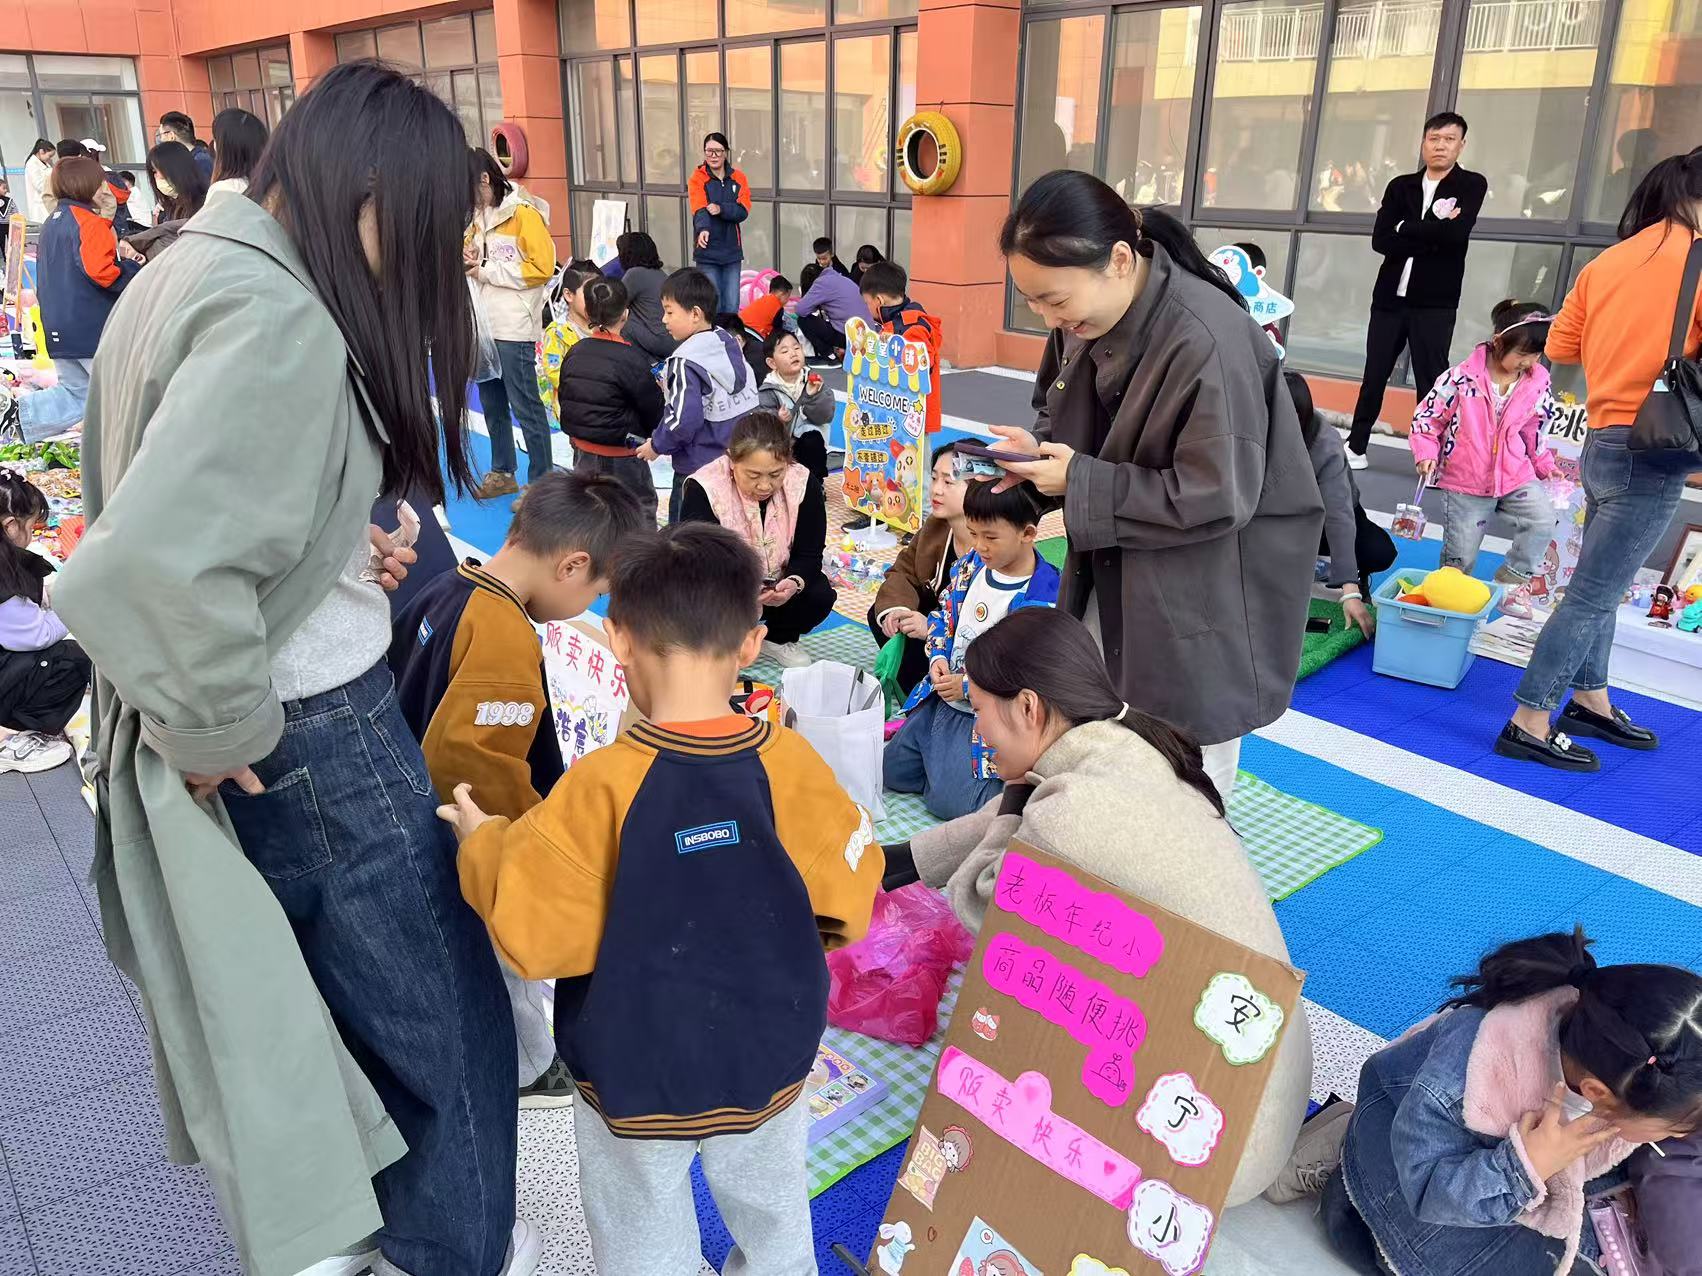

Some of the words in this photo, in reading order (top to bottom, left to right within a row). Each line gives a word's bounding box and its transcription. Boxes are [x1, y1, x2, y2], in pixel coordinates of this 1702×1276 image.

[1253, 301, 1277, 314] 商店
[859, 385, 910, 413] WELCOME
[860, 424, 890, 438] 走过路过
[857, 451, 885, 464] 不要错过
[545, 622, 627, 699] 贩卖快乐
[474, 702, 535, 726] 1998
[684, 828, 730, 847] INSBOBO
[1001, 865, 1142, 957] 老板年纪小
[994, 943, 1140, 1048] 商品随便挑
[959, 1066, 1085, 1170] 贩卖快乐
[914, 1151, 942, 1180] BAG
[920, 1141, 944, 1168] BIG
